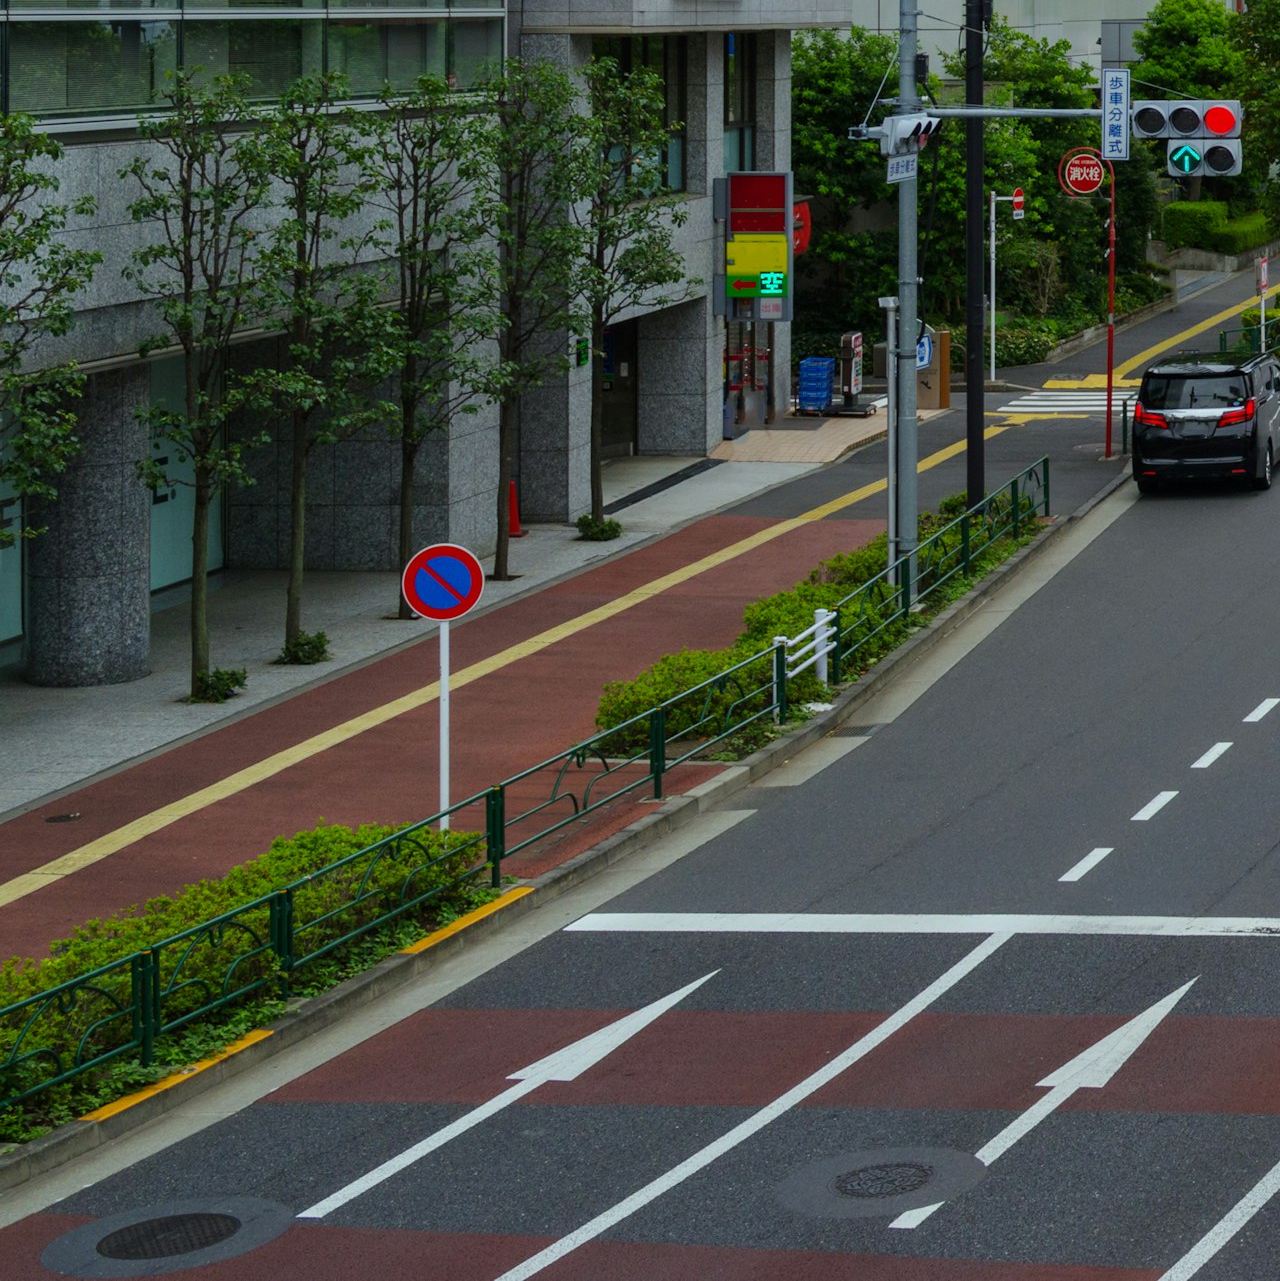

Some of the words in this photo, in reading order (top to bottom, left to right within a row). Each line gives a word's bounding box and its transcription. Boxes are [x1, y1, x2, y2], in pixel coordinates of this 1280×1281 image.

[1108, 76, 1123, 154] 歩車分離式
[1069, 166, 1100, 181] 消火栓
[760, 272, 784, 294] 空
